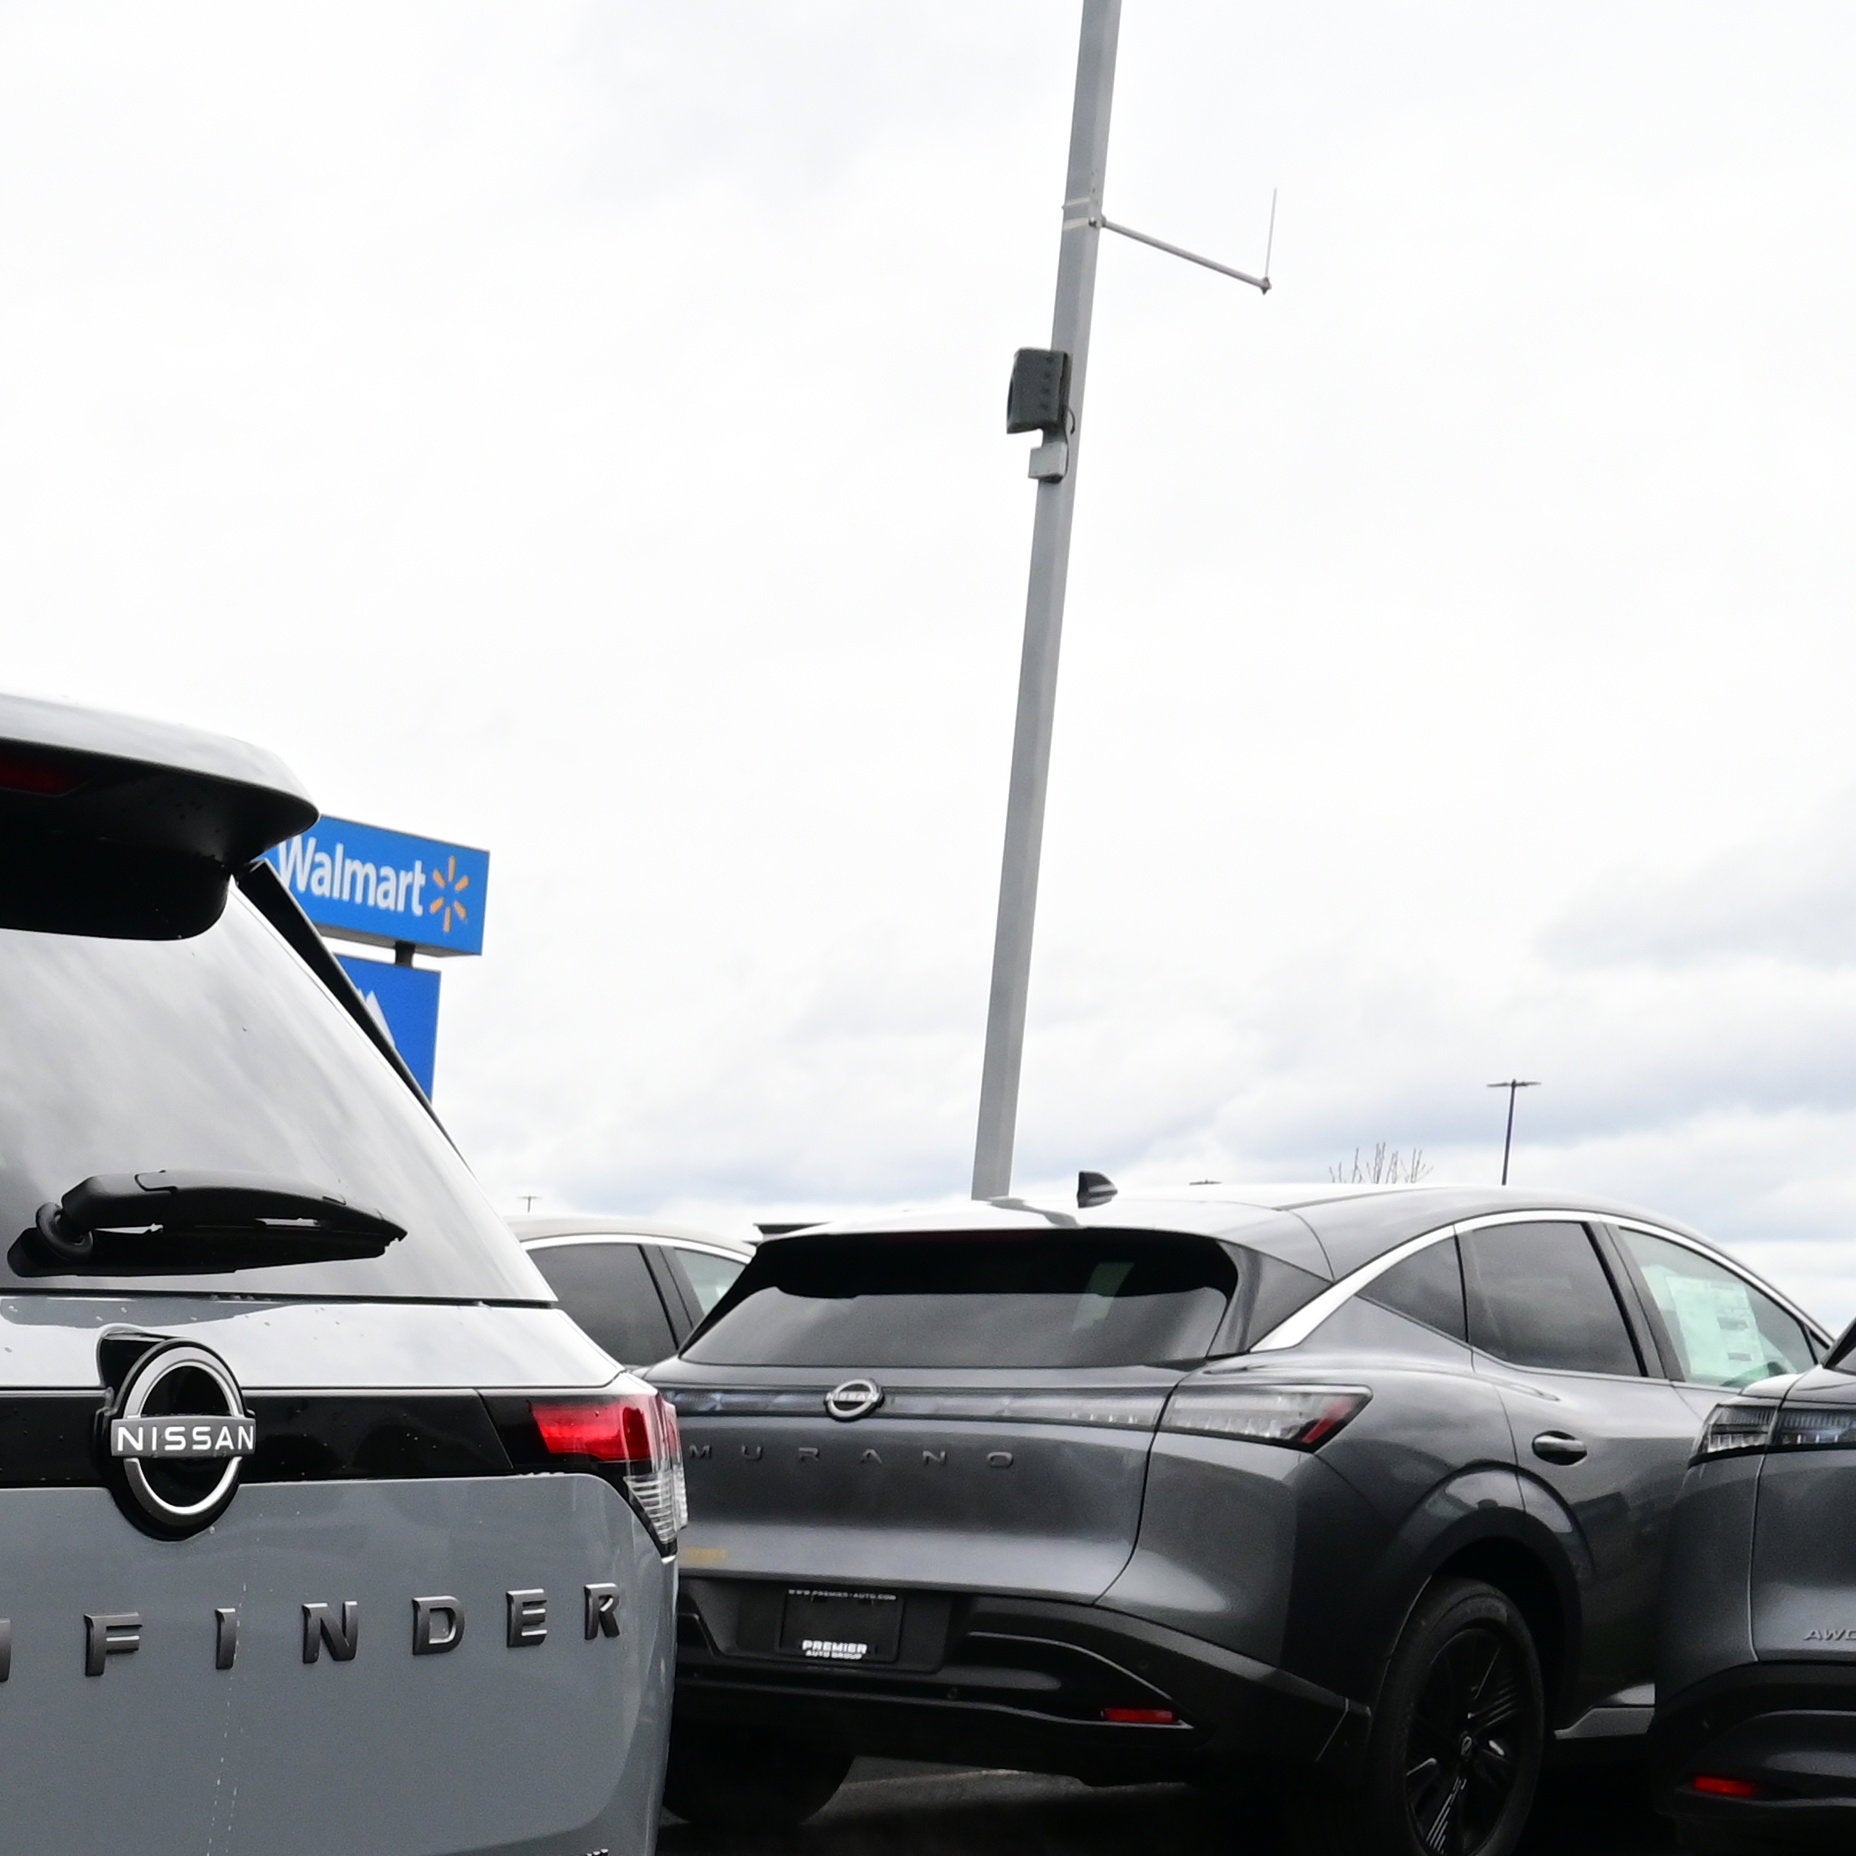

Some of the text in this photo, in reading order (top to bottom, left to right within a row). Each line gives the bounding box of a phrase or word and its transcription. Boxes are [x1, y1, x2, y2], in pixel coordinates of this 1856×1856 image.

[278, 834, 426, 916] Walmart
[117, 1426, 254, 1451] NISSAN
[688, 1444, 1014, 1469] MURANO
[802, 1640, 867, 1654] PREMIER
